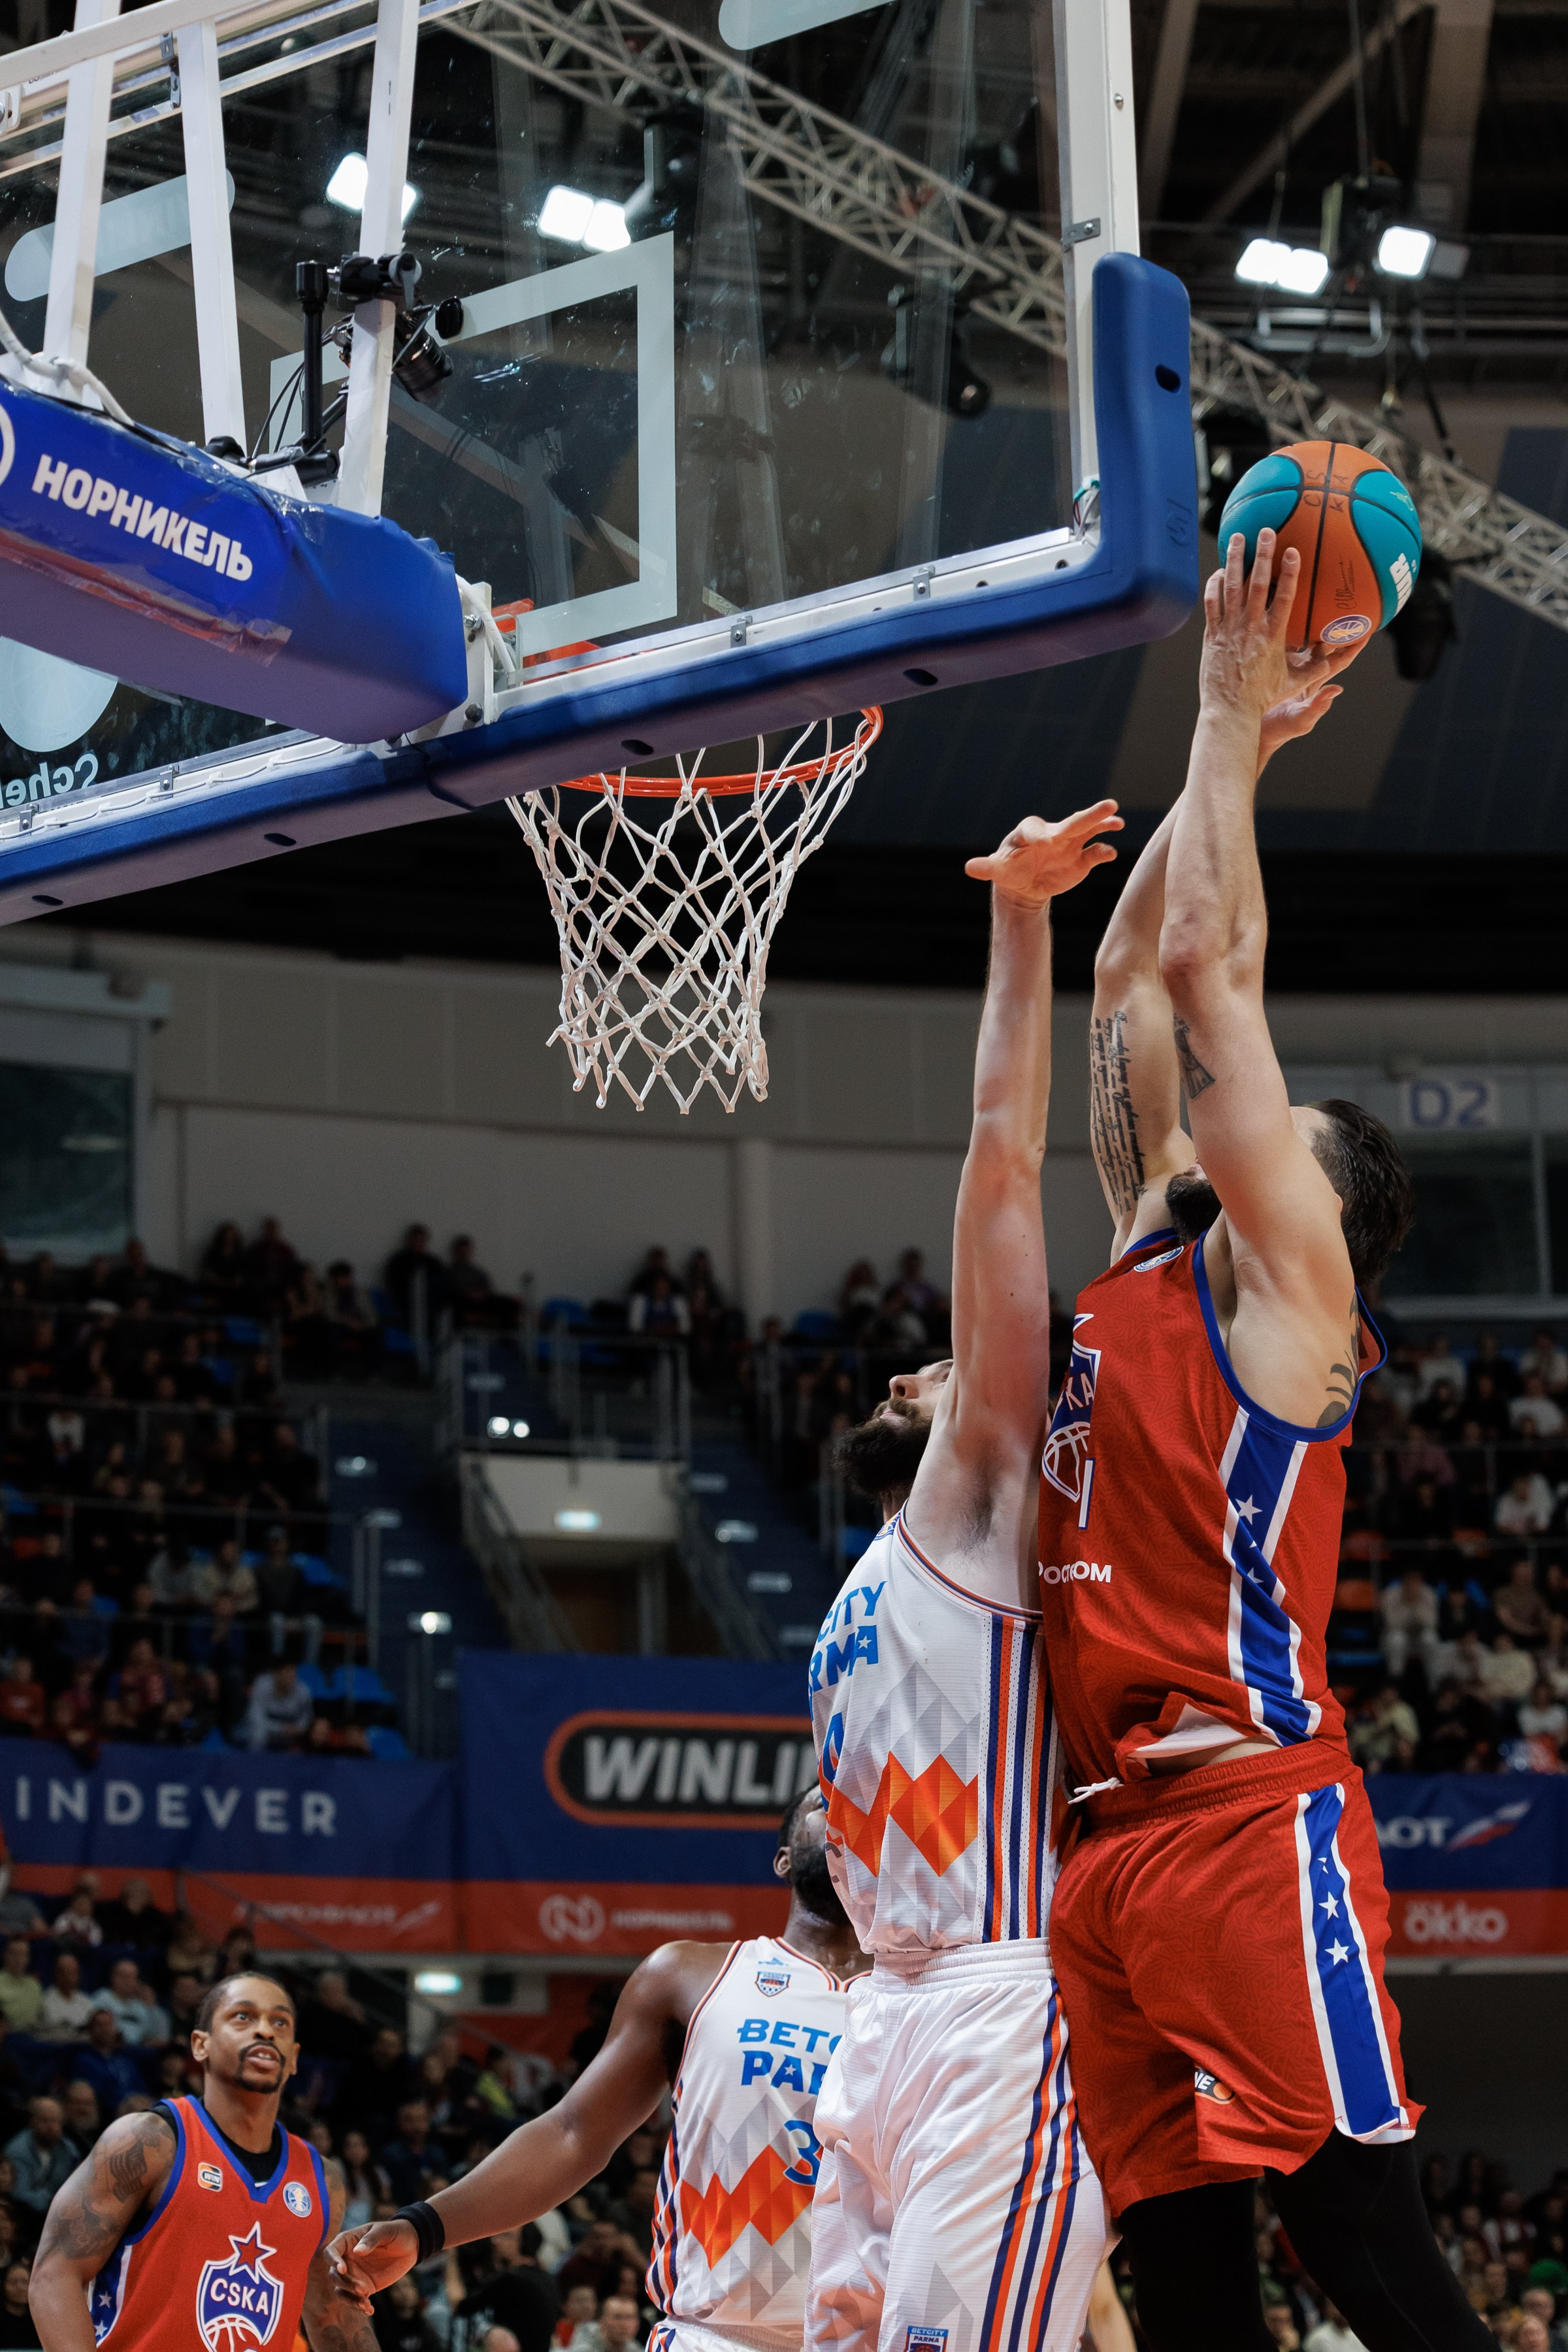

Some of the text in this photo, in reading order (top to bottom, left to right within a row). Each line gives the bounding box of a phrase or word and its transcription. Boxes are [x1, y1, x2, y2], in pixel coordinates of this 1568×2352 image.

[31, 454, 253, 581] НОРНИКЕЛЬ
[1410, 1079, 1488, 1126] D2
[809, 1624, 879, 1699] RMA
[16, 1775, 337, 1836] INDEVER
[783, 2119, 821, 2186] 3
[210, 2278, 269, 2316] CSKA
[911, 2327, 945, 2336] BETCITY
